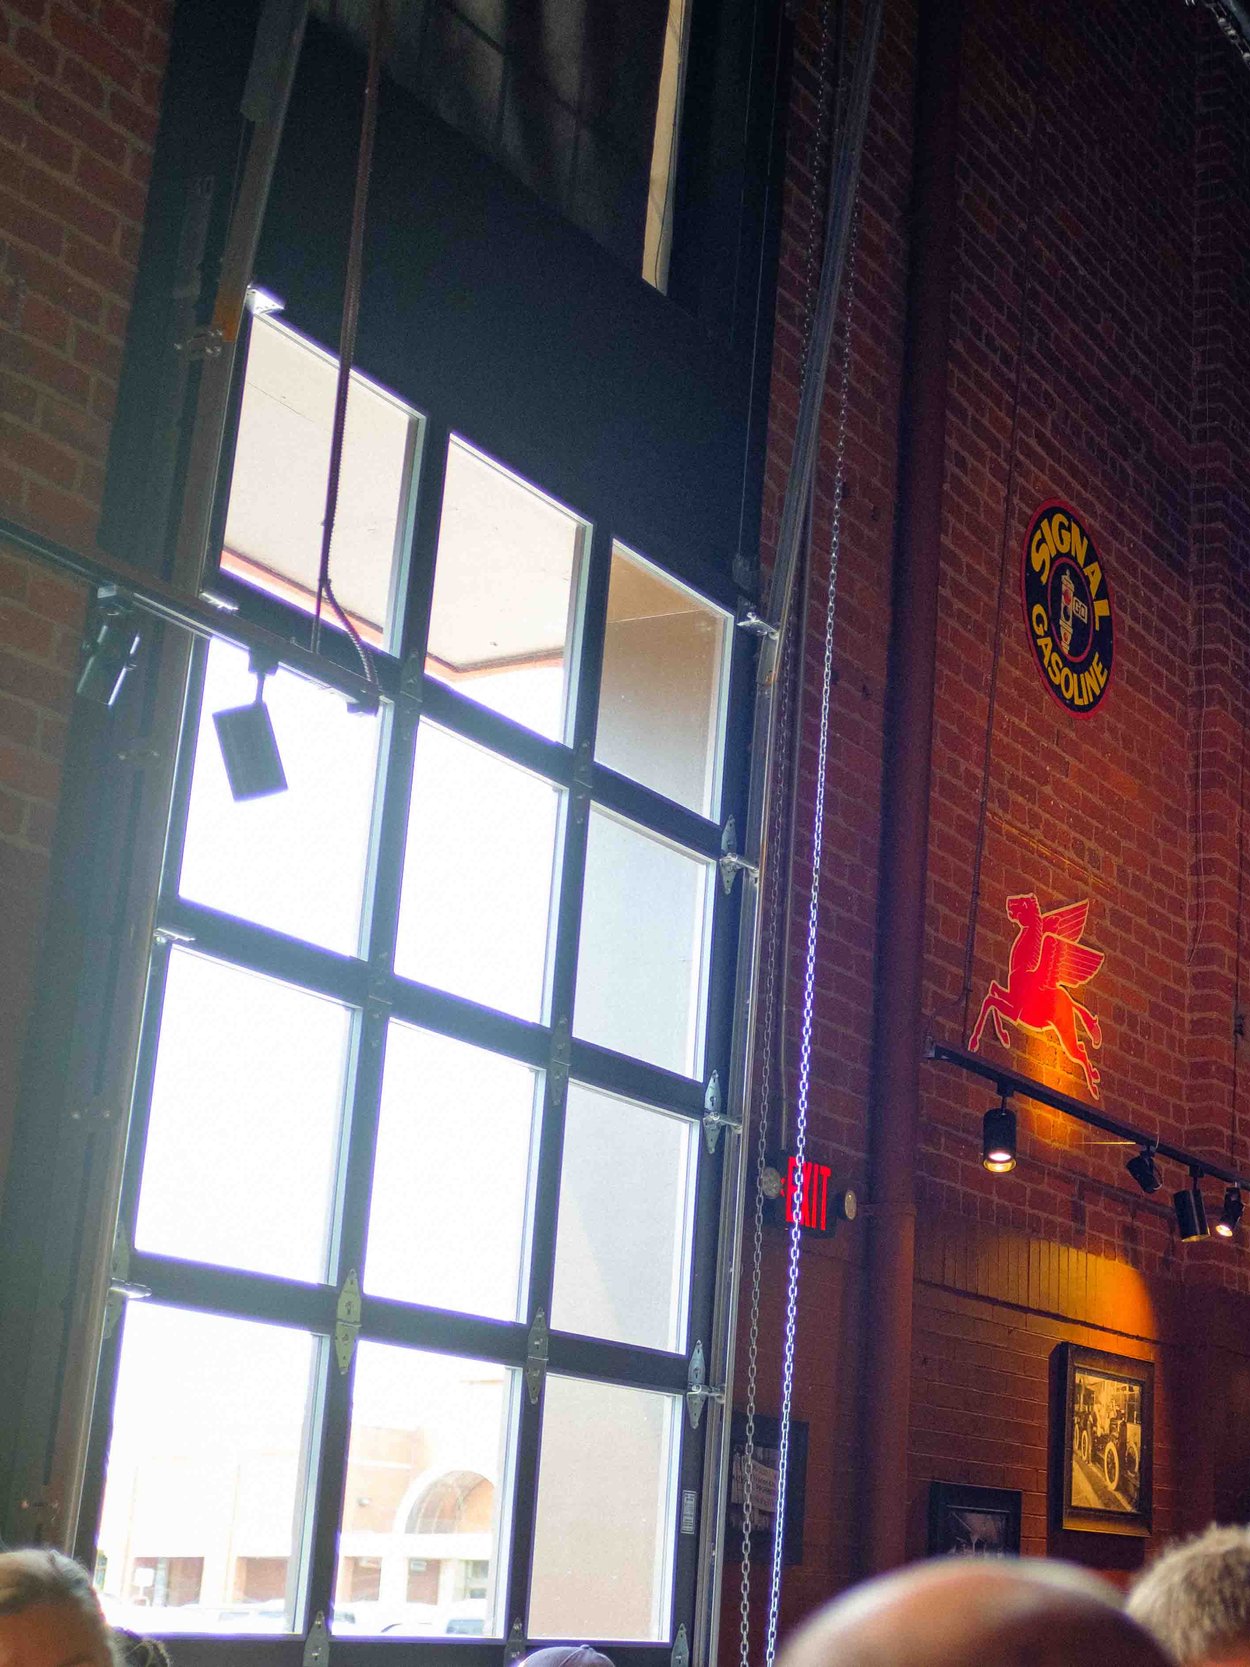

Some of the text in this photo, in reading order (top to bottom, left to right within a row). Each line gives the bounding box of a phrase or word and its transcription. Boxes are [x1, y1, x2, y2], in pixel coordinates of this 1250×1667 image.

[1031, 513, 1110, 631] SIGNAL
[1031, 603, 1108, 706] GASOLINE
[785, 1156, 832, 1231] EXIT
